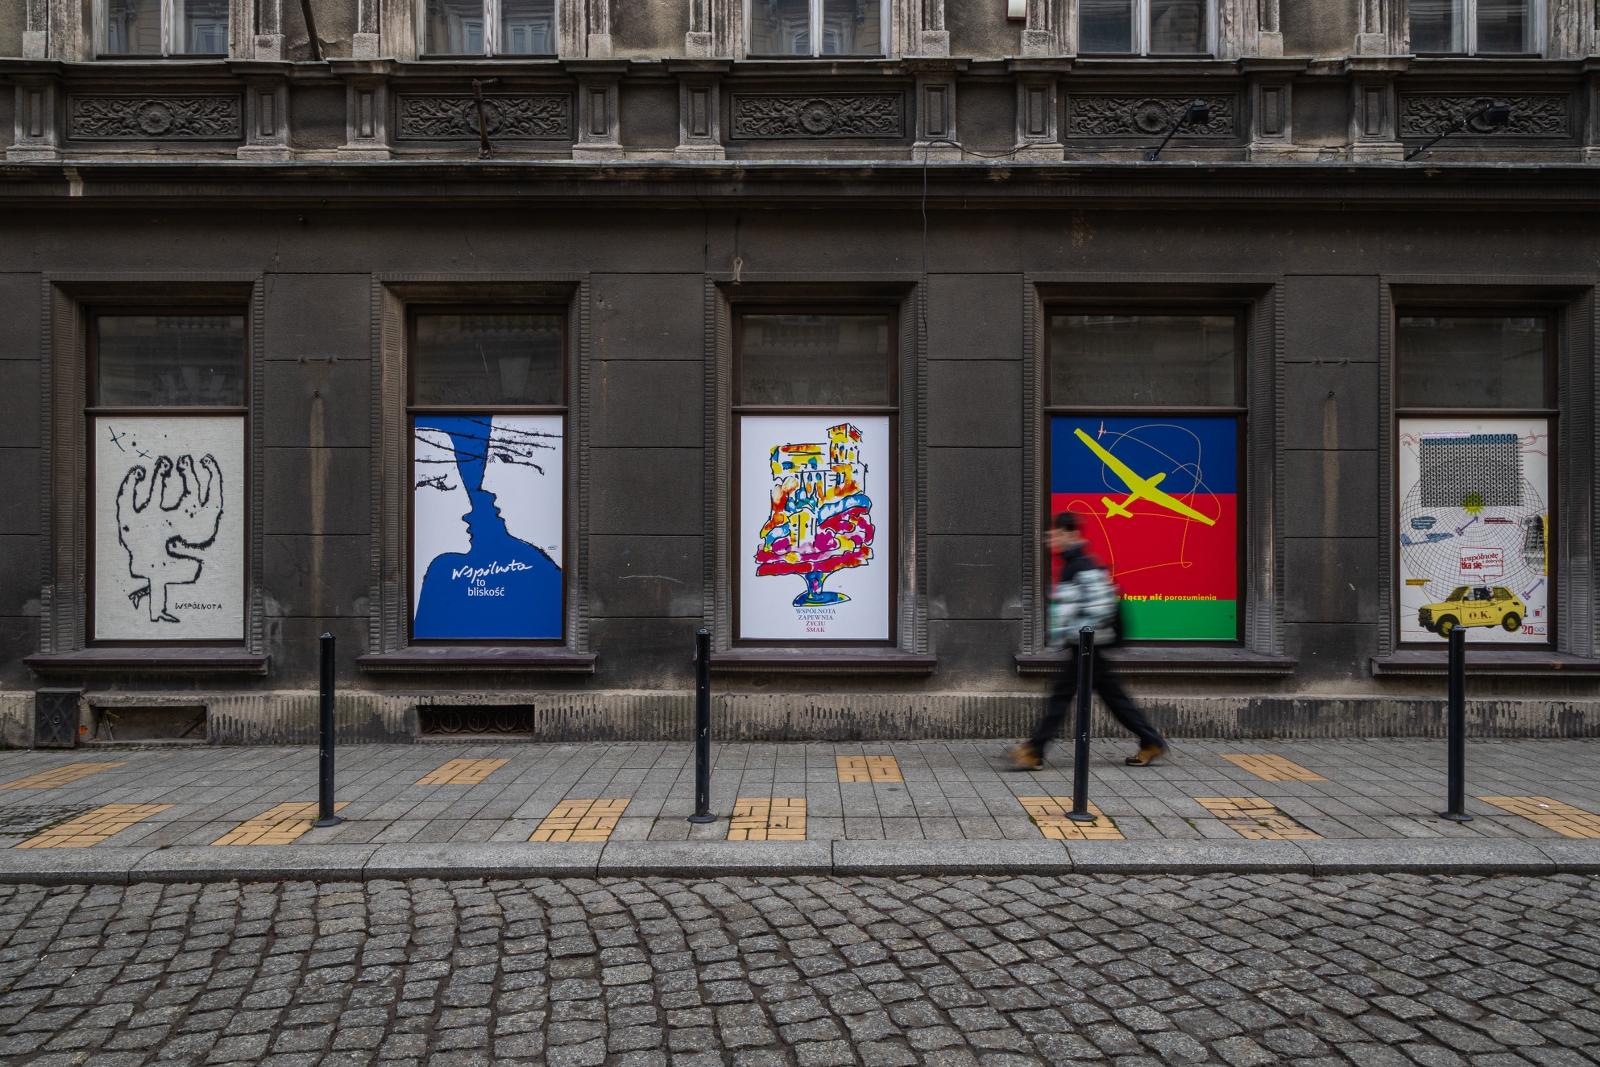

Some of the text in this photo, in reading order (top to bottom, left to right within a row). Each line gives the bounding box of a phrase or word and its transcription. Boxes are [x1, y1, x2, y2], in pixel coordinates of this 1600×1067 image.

[476, 578, 486, 587] to
[467, 586, 505, 596] bliskość
[1123, 593, 1148, 602] łączy
[1150, 593, 1162, 601] nić
[1164, 593, 1217, 602] porozumienia
[1469, 611, 1492, 621] O.K.
